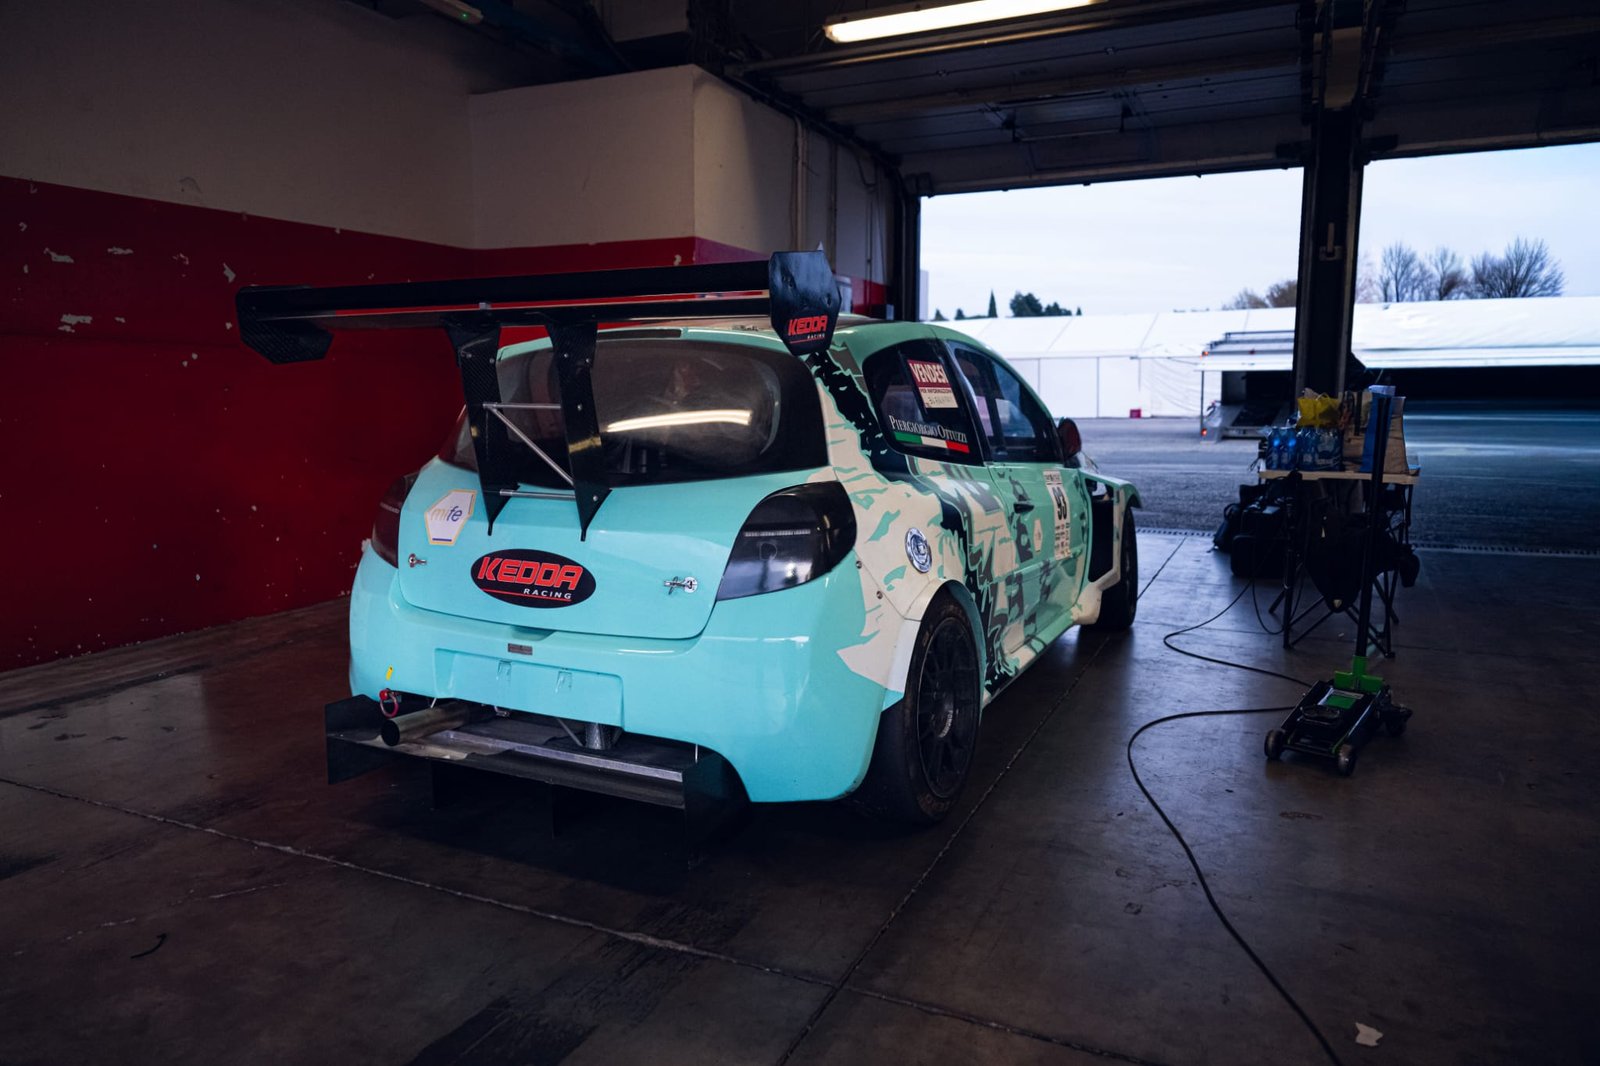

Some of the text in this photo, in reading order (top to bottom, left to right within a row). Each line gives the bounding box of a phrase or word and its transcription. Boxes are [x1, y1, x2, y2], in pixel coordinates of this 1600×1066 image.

[788, 315, 828, 336] KEDDA
[909, 362, 949, 383] VENDESI
[1052, 487, 1067, 520] 93
[477, 556, 583, 590] KEDDA
[523, 588, 572, 600] RACING
